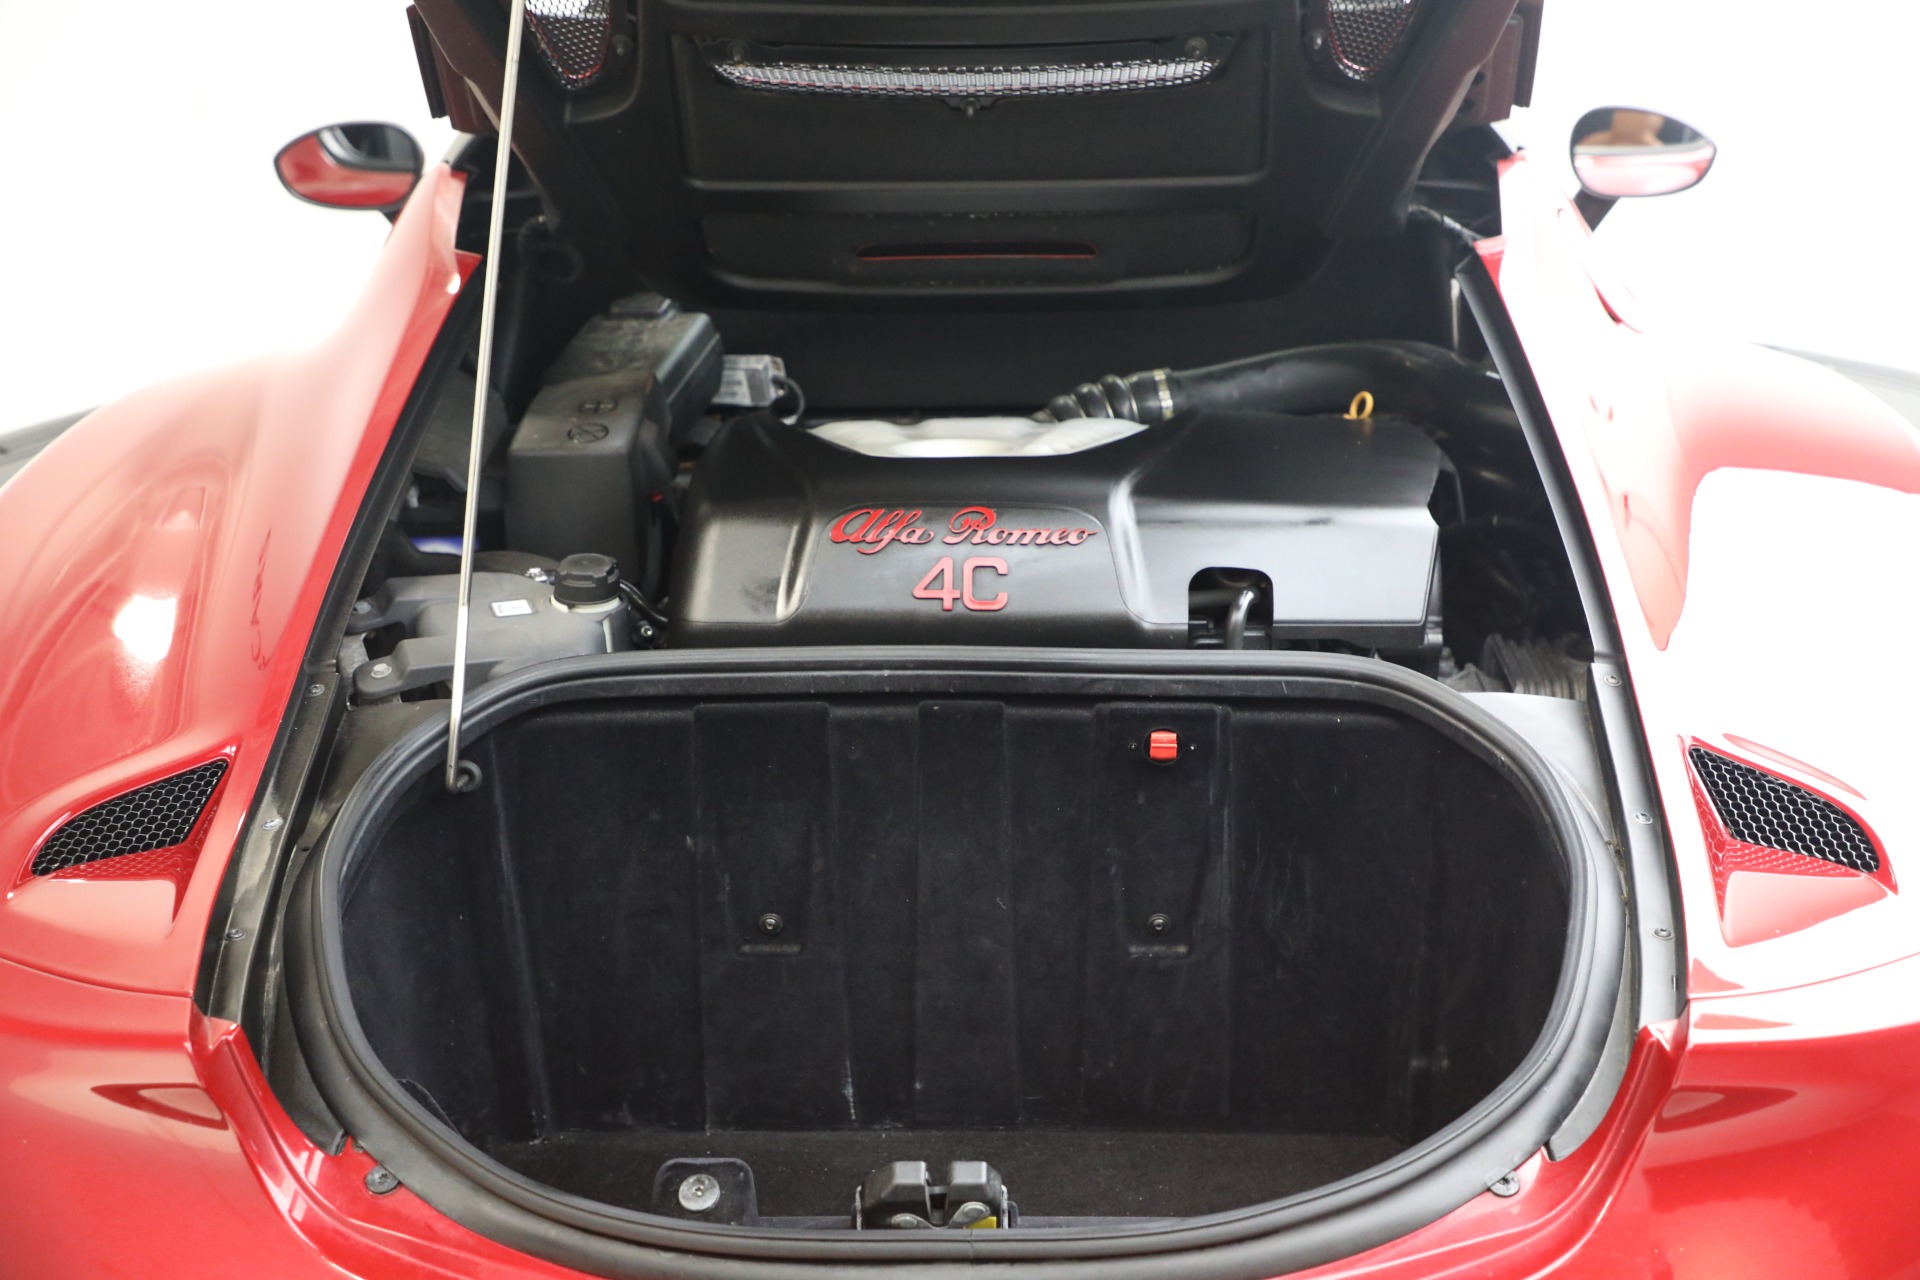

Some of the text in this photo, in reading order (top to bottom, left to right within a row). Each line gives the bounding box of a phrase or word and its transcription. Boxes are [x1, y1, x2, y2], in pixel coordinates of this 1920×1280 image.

[829, 506, 1099, 555] Alfa Romeo
[912, 556, 1008, 611] 4C
